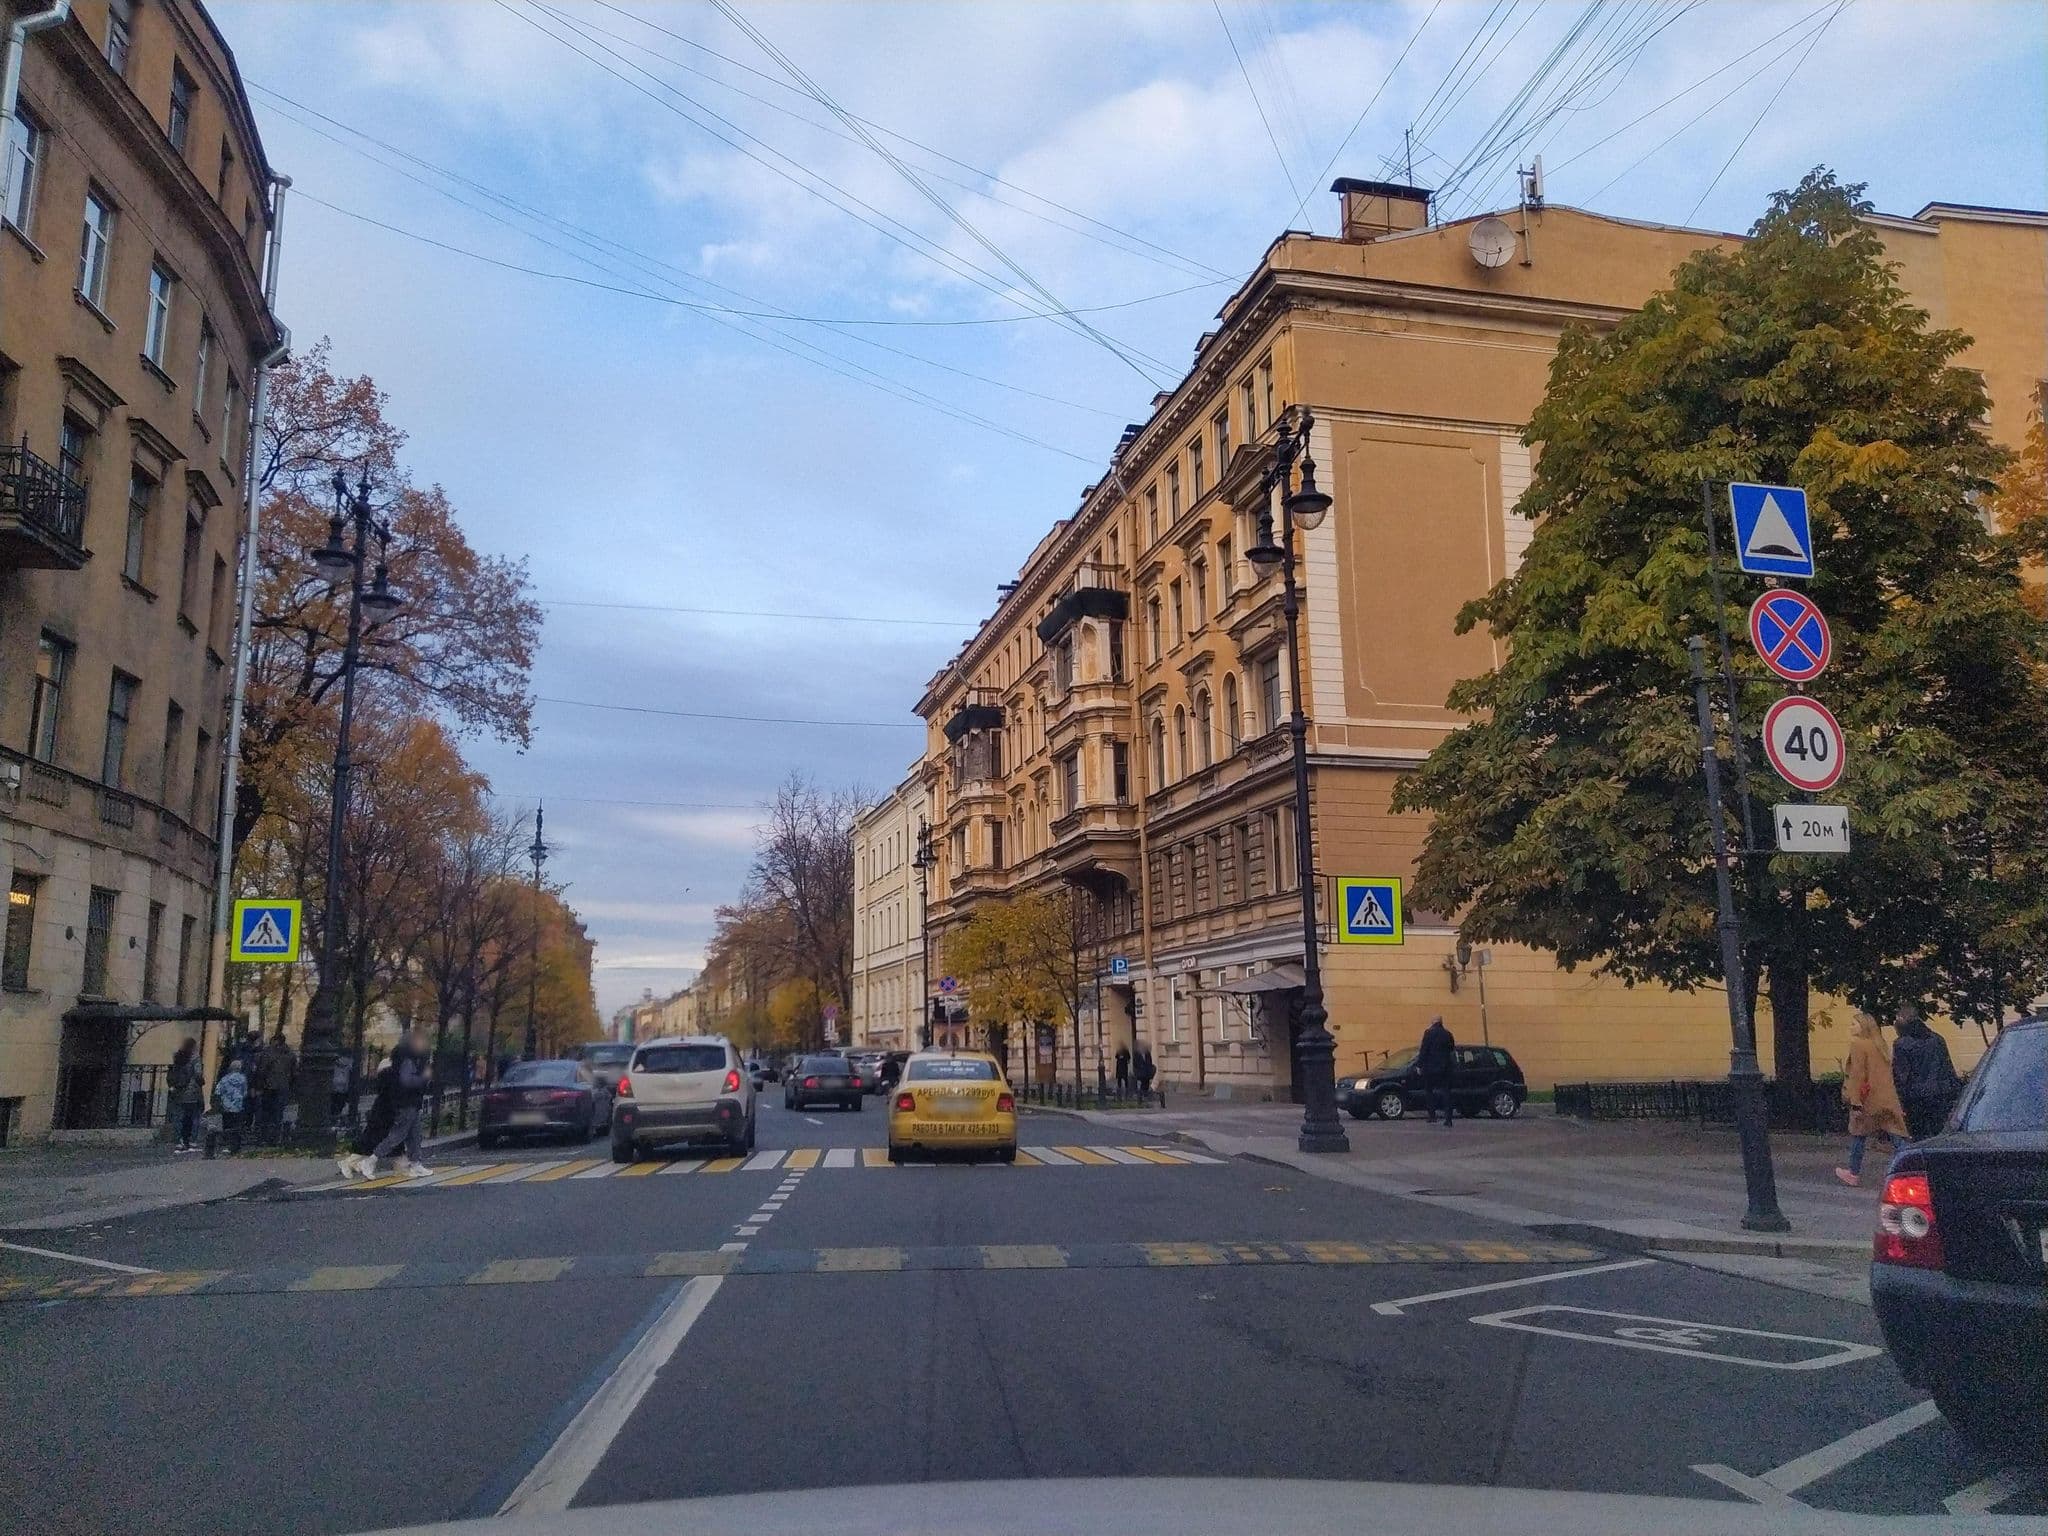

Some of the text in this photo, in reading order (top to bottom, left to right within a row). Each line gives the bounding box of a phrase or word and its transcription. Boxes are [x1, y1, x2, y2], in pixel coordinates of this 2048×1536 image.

[1784, 725, 1828, 762] 40
[9, 891, 31, 905] TASTY
[912, 1123, 938, 1135] РАБОТА
[945, 1123, 966, 1135] ТАКСИ
